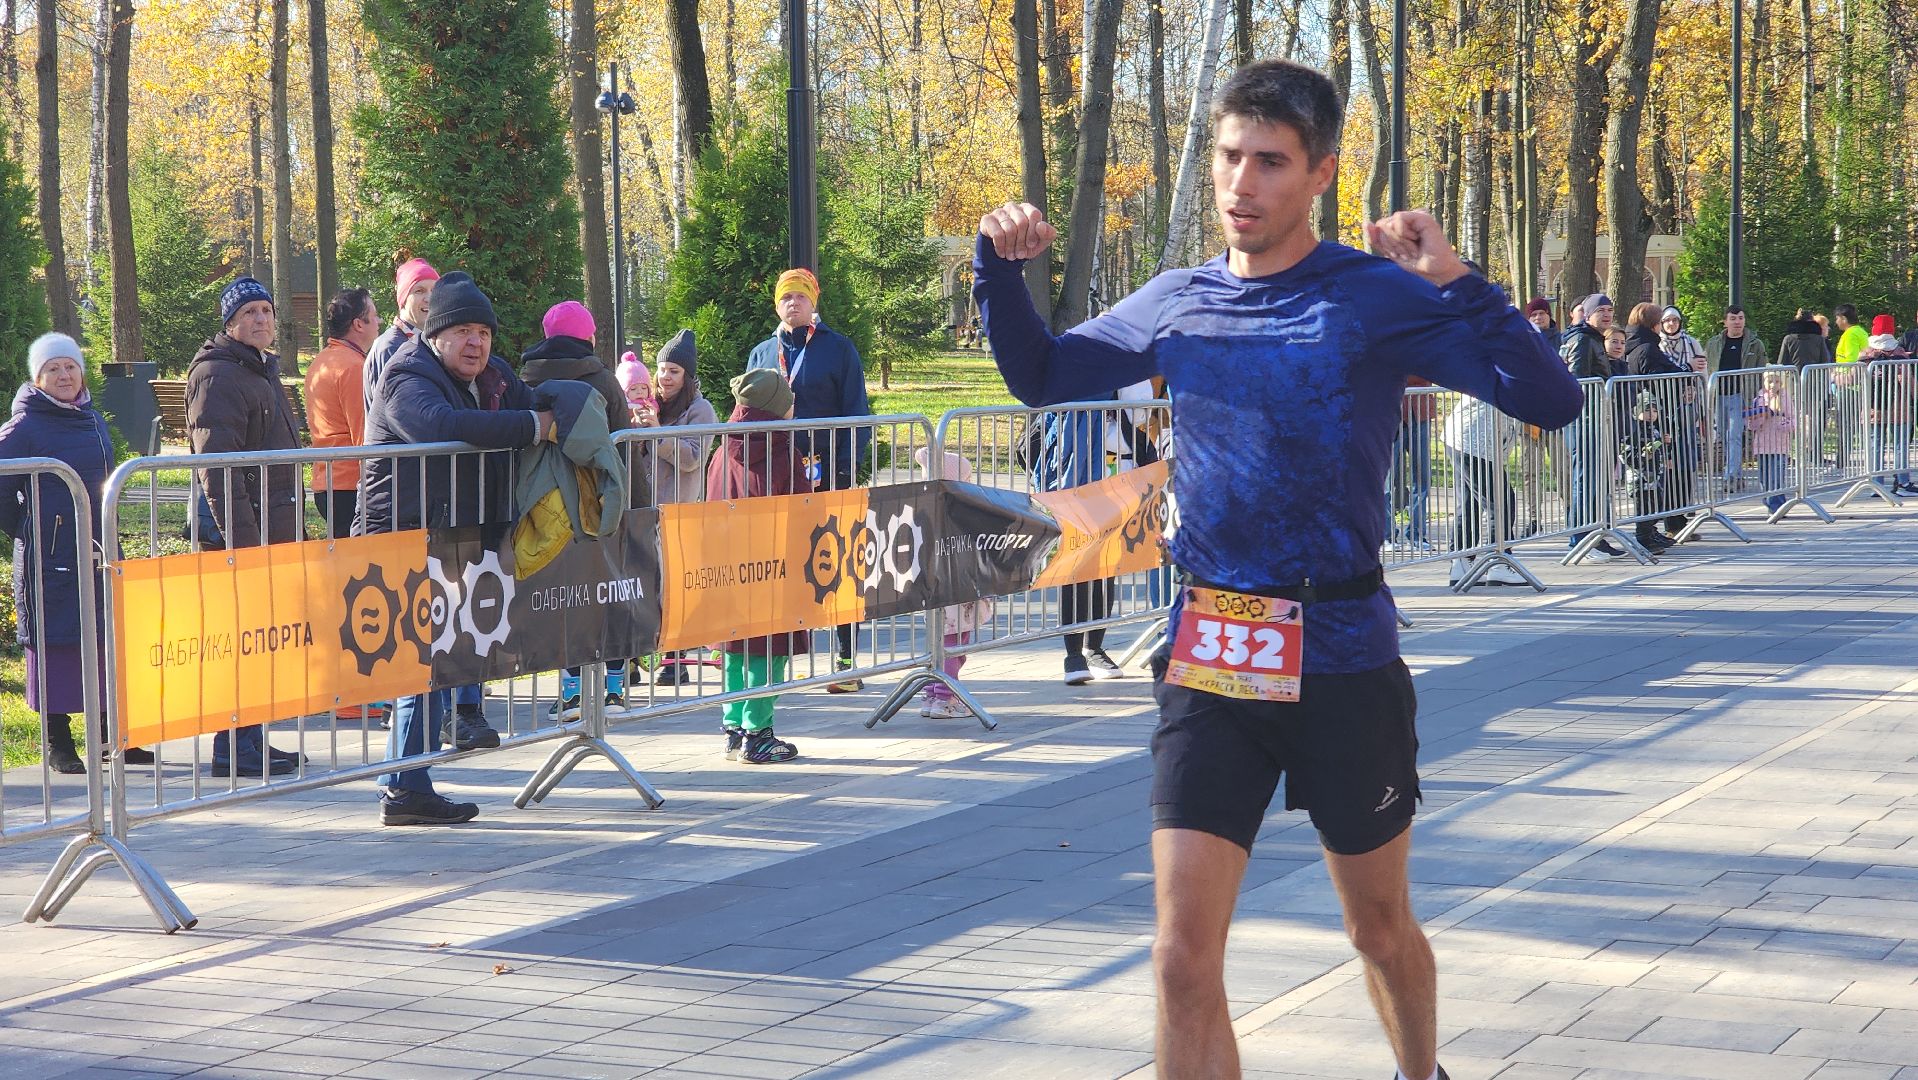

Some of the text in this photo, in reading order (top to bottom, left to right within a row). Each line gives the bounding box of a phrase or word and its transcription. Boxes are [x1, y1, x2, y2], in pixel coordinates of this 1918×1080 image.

[976, 533, 1033, 551] СПОРТА
[684, 558, 787, 591] ФАБРИКА СПОРТА
[531, 576, 644, 612] ФАБРИКА СПОРТА
[149, 621, 314, 669] ФАБРИКА СПОРТА
[1190, 619, 1285, 670] 332
